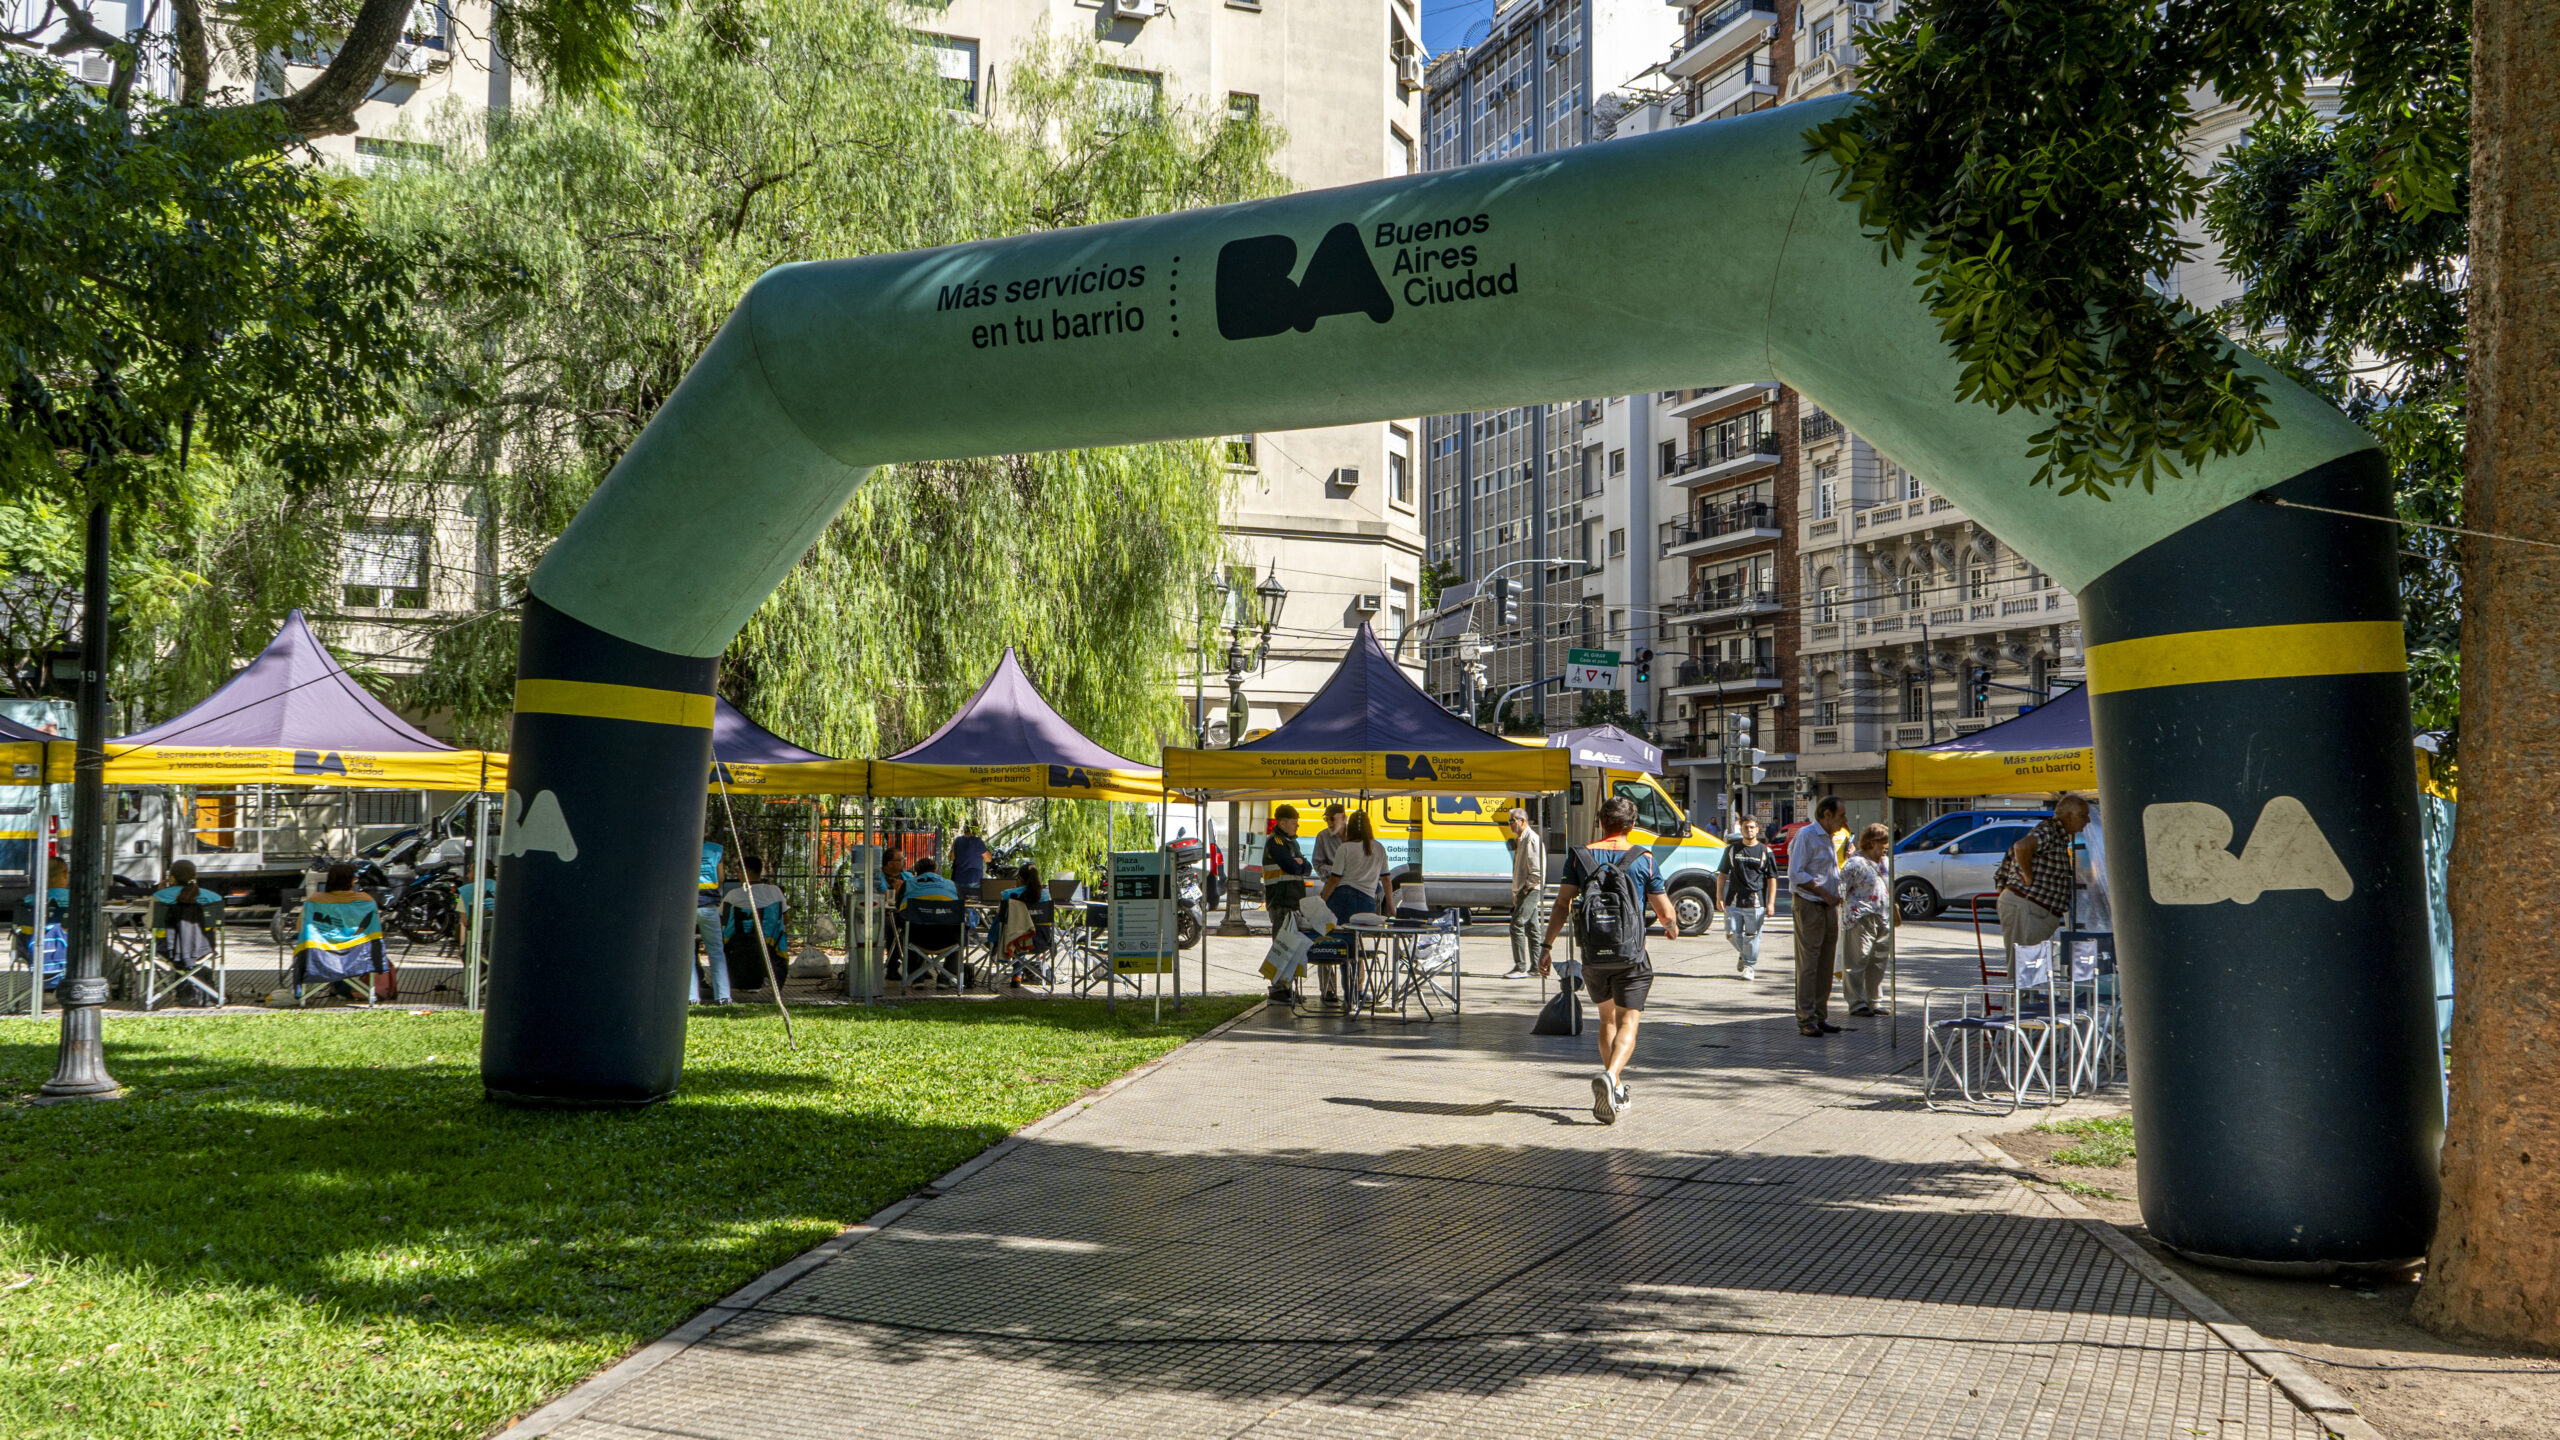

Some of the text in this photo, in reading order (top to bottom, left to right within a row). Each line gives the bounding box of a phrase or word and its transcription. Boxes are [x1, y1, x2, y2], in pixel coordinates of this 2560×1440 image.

[1374, 213, 1490, 248] Buenos
[1392, 244, 1478, 276] Aires
[1215, 222, 1394, 341] BA
[1403, 263, 1519, 307] Ciudad
[936, 263, 1146, 312] Más servicios
[971, 301, 1145, 349] en tu barrio
[208, 751, 221, 759] de
[223, 751, 269, 759] Gobierno
[343, 752, 377, 760] Buenos
[1579, 749, 1608, 763] BA
[2003, 751, 2081, 765] Más servicios
[294, 750, 347, 777] BA
[349, 760, 374, 768] Aires
[1308, 757, 1319, 766] de
[1321, 756, 1363, 765] Gobierno
[1432, 756, 1464, 764] Buenos
[168, 763, 174, 771] y
[730, 763, 760, 771] Buenos
[969, 766, 1031, 774] Más servicios
[1385, 754, 1438, 781] BA
[1437, 764, 1461, 772] Aires
[2015, 761, 2081, 775] en tu barrio
[351, 768, 384, 776] Ciudad
[1086, 769, 1112, 778] Buenos
[1272, 769, 1277, 777] y
[1314, 767, 1362, 776] Ciudadano
[1440, 771, 1472, 780] Ciudad
[737, 777, 766, 785] Ciudad
[981, 775, 1031, 784] en tu barrio
[1048, 765, 1091, 789] BA
[1093, 781, 1119, 789] Ciudad
[1386, 845, 1420, 853] Gobierno
[2142, 795, 2354, 905] BA
[1116, 856, 1139, 864] Plaza
[1116, 865, 1145, 873] Lavalle
